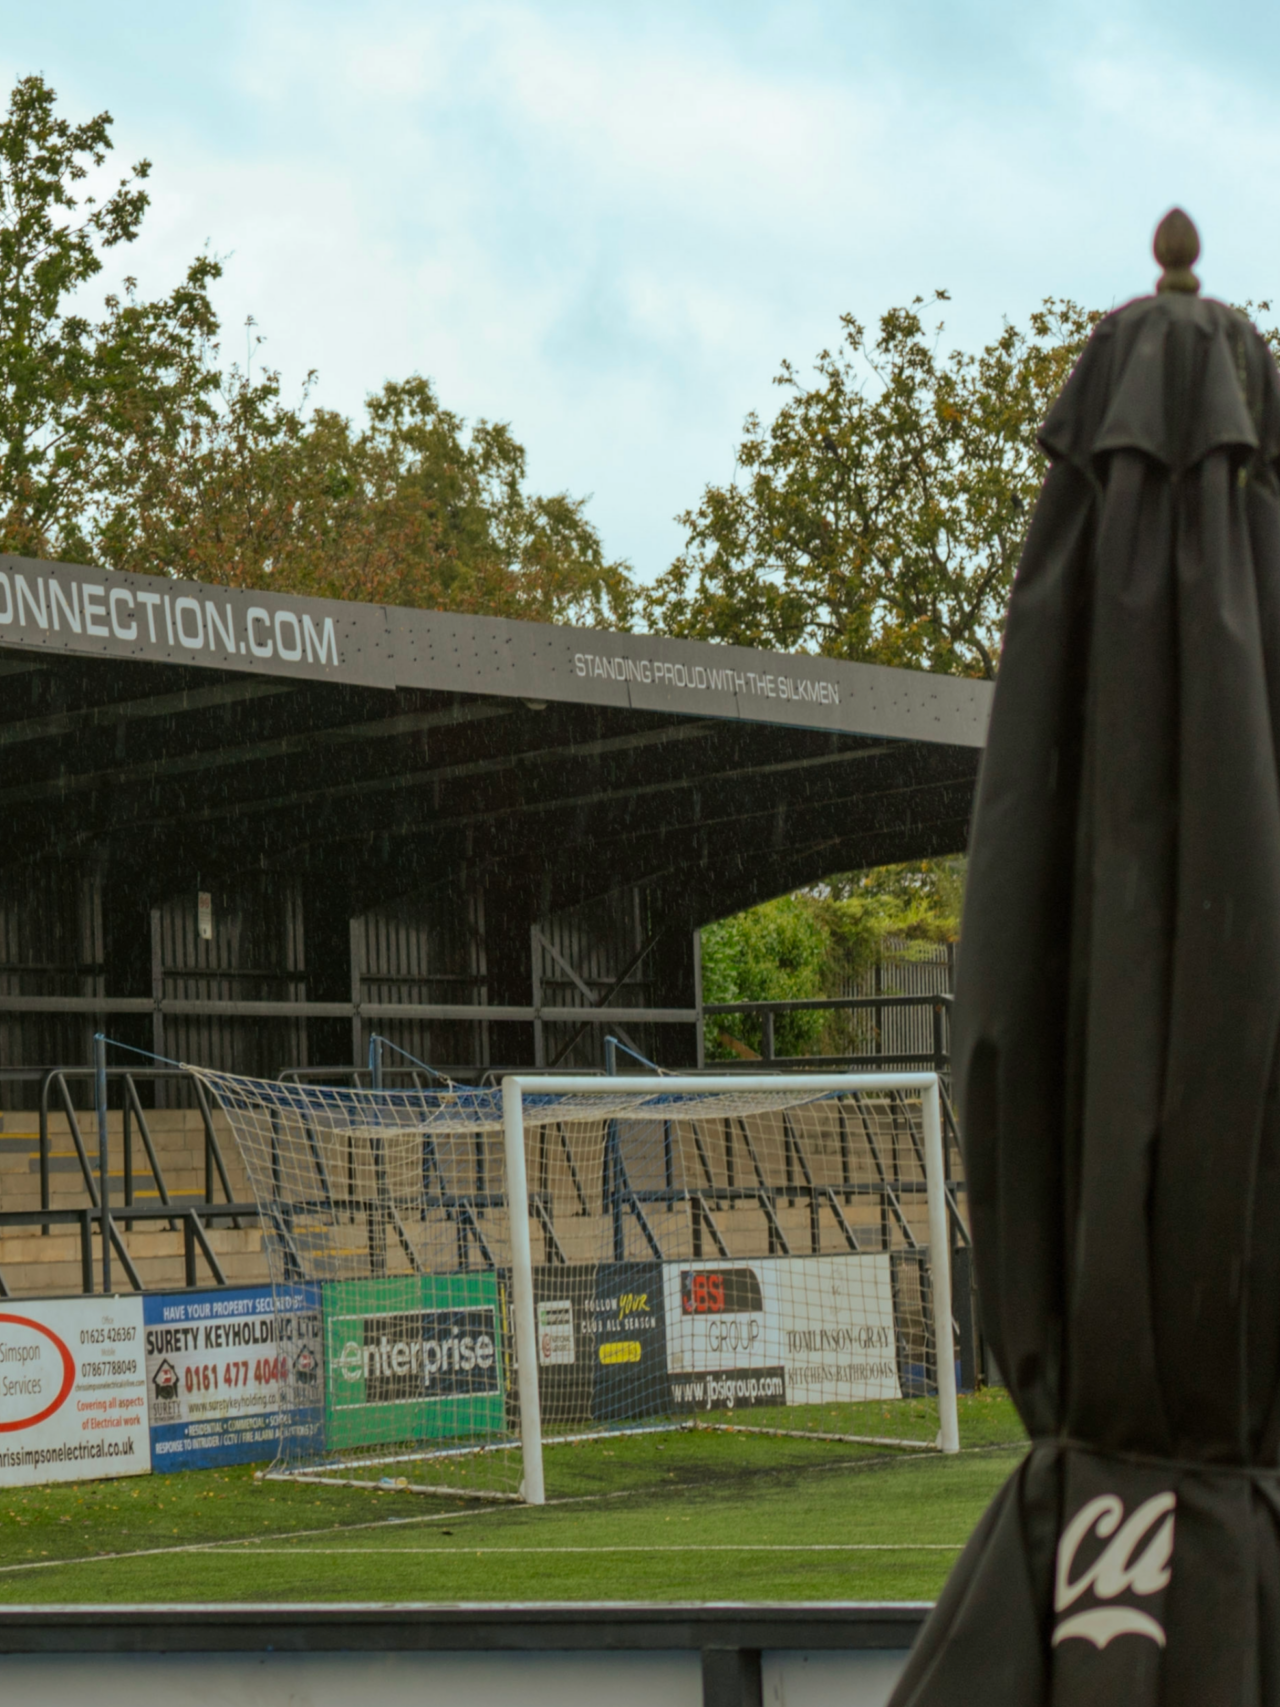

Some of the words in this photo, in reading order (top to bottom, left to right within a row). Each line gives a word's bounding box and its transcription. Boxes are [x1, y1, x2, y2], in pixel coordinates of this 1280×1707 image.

[574, 653, 652, 683] STANDING
[654, 663, 707, 690] PROUD
[709, 668, 746, 694] WITH
[747, 672, 776, 697] THE
[777, 676, 840, 705] SILKMEN
[163, 1305, 186, 1321] HAVE
[187, 1303, 212, 1319] YOUR
[213, 1299, 254, 1317] PROPERTY
[585, 1298, 617, 1312] FOLLOW
[619, 1293, 650, 1321] YOUR
[80, 1328, 106, 1345] 01625
[106, 1327, 137, 1343] 426367
[146, 1327, 200, 1356] SURETY
[205, 1317, 293, 1349] KEYHOLDING
[582, 1320, 602, 1333] CLUB
[607, 1319, 621, 1331] ALL
[624, 1316, 656, 1330] SEASON
[709, 1319, 759, 1352] GROUP
[786, 1328, 852, 1353] TOMLINSON
[858, 1326, 890, 1350] GRAY
[0, 1342, 41, 1366] Simspon
[340, 1326, 494, 1387] enterprise
[185, 1363, 218, 1393] 0161
[224, 1360, 249, 1388] 477
[788, 1364, 833, 1385] KITCHENS
[836, 1361, 894, 1382] BATHROOMS
[2, 1375, 42, 1397] Services
[672, 1374, 783, 1410] www.jbsigroup.com
[77, 1398, 107, 1413] Covering
[108, 1396, 117, 1409] all
[118, 1396, 144, 1411] aspects
[152, 1400, 181, 1417] SURETY
[82, 1418, 90, 1431] of
[91, 1416, 122, 1430] Electrical
[123, 1414, 141, 1427] work
[155, 1440, 183, 1455] RESPONSE
